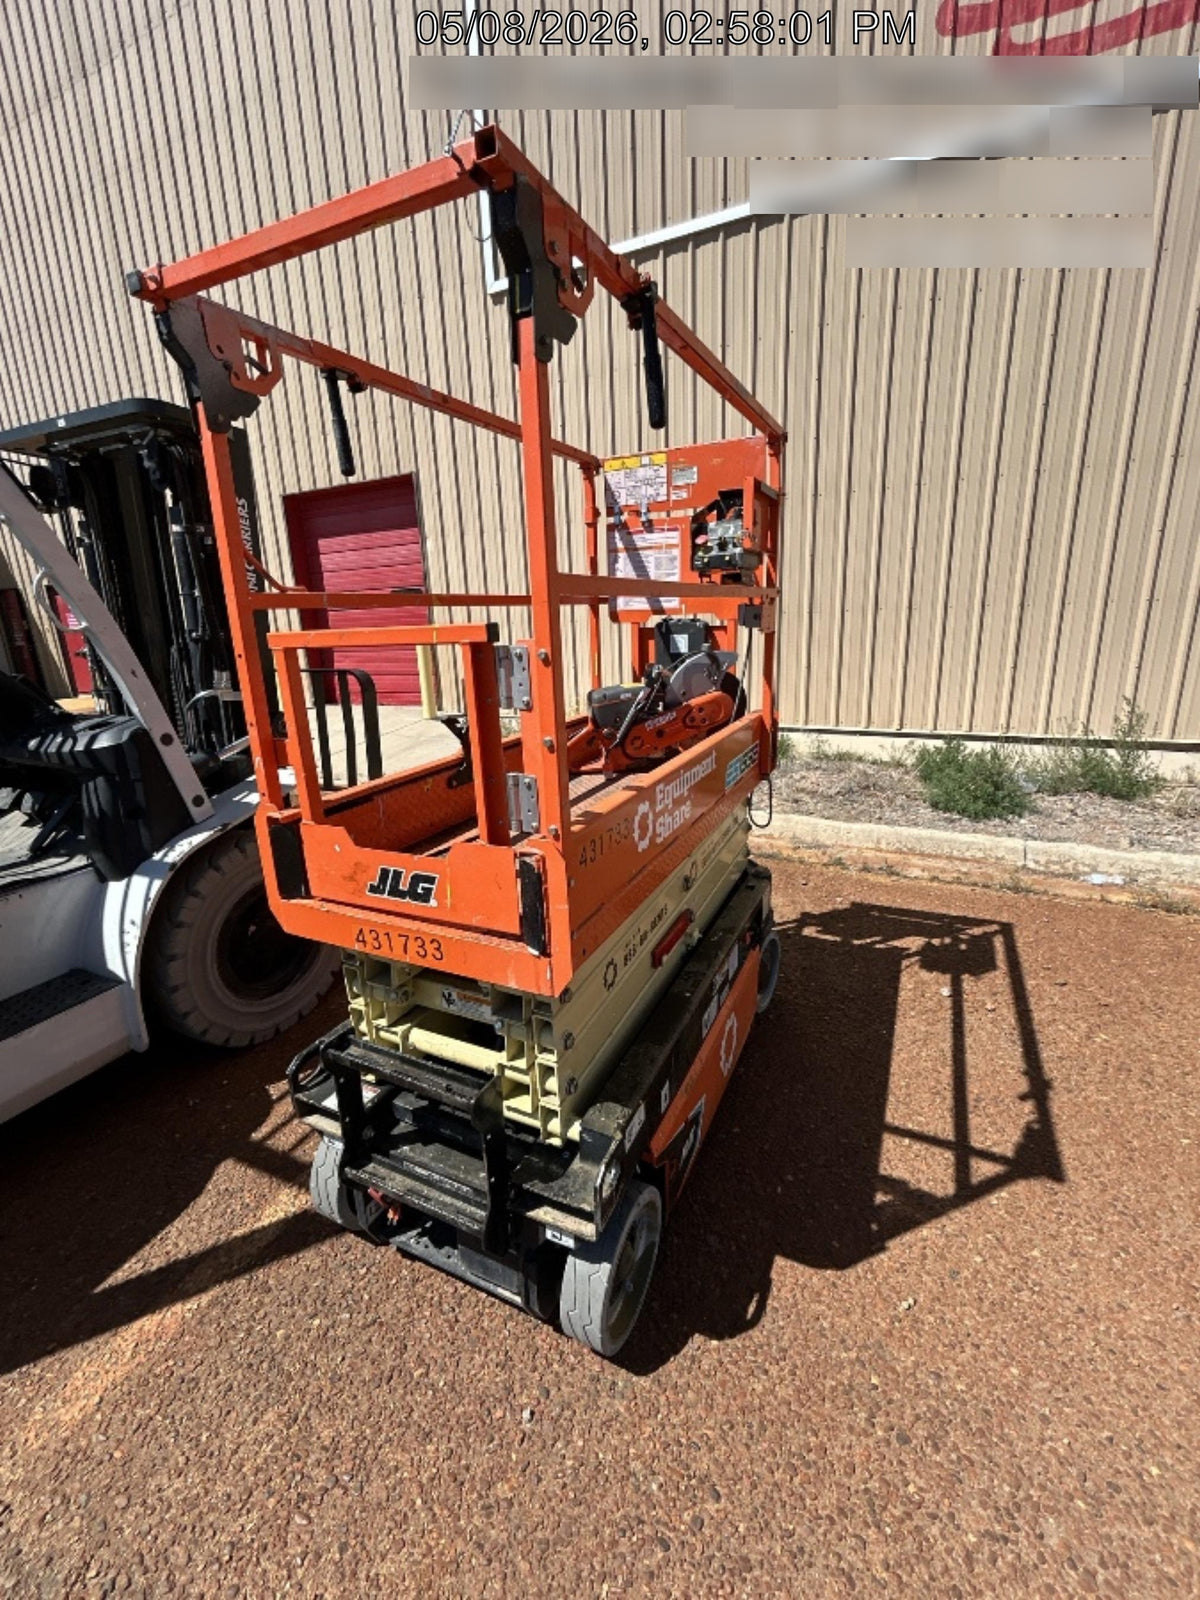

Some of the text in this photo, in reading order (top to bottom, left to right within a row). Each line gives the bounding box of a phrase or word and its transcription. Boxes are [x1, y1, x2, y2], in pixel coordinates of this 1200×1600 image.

[655, 749, 718, 813] Equipment
[655, 799, 692, 844] Share
[366, 865, 439, 906] JLG
[355, 927, 444, 961] 431733
